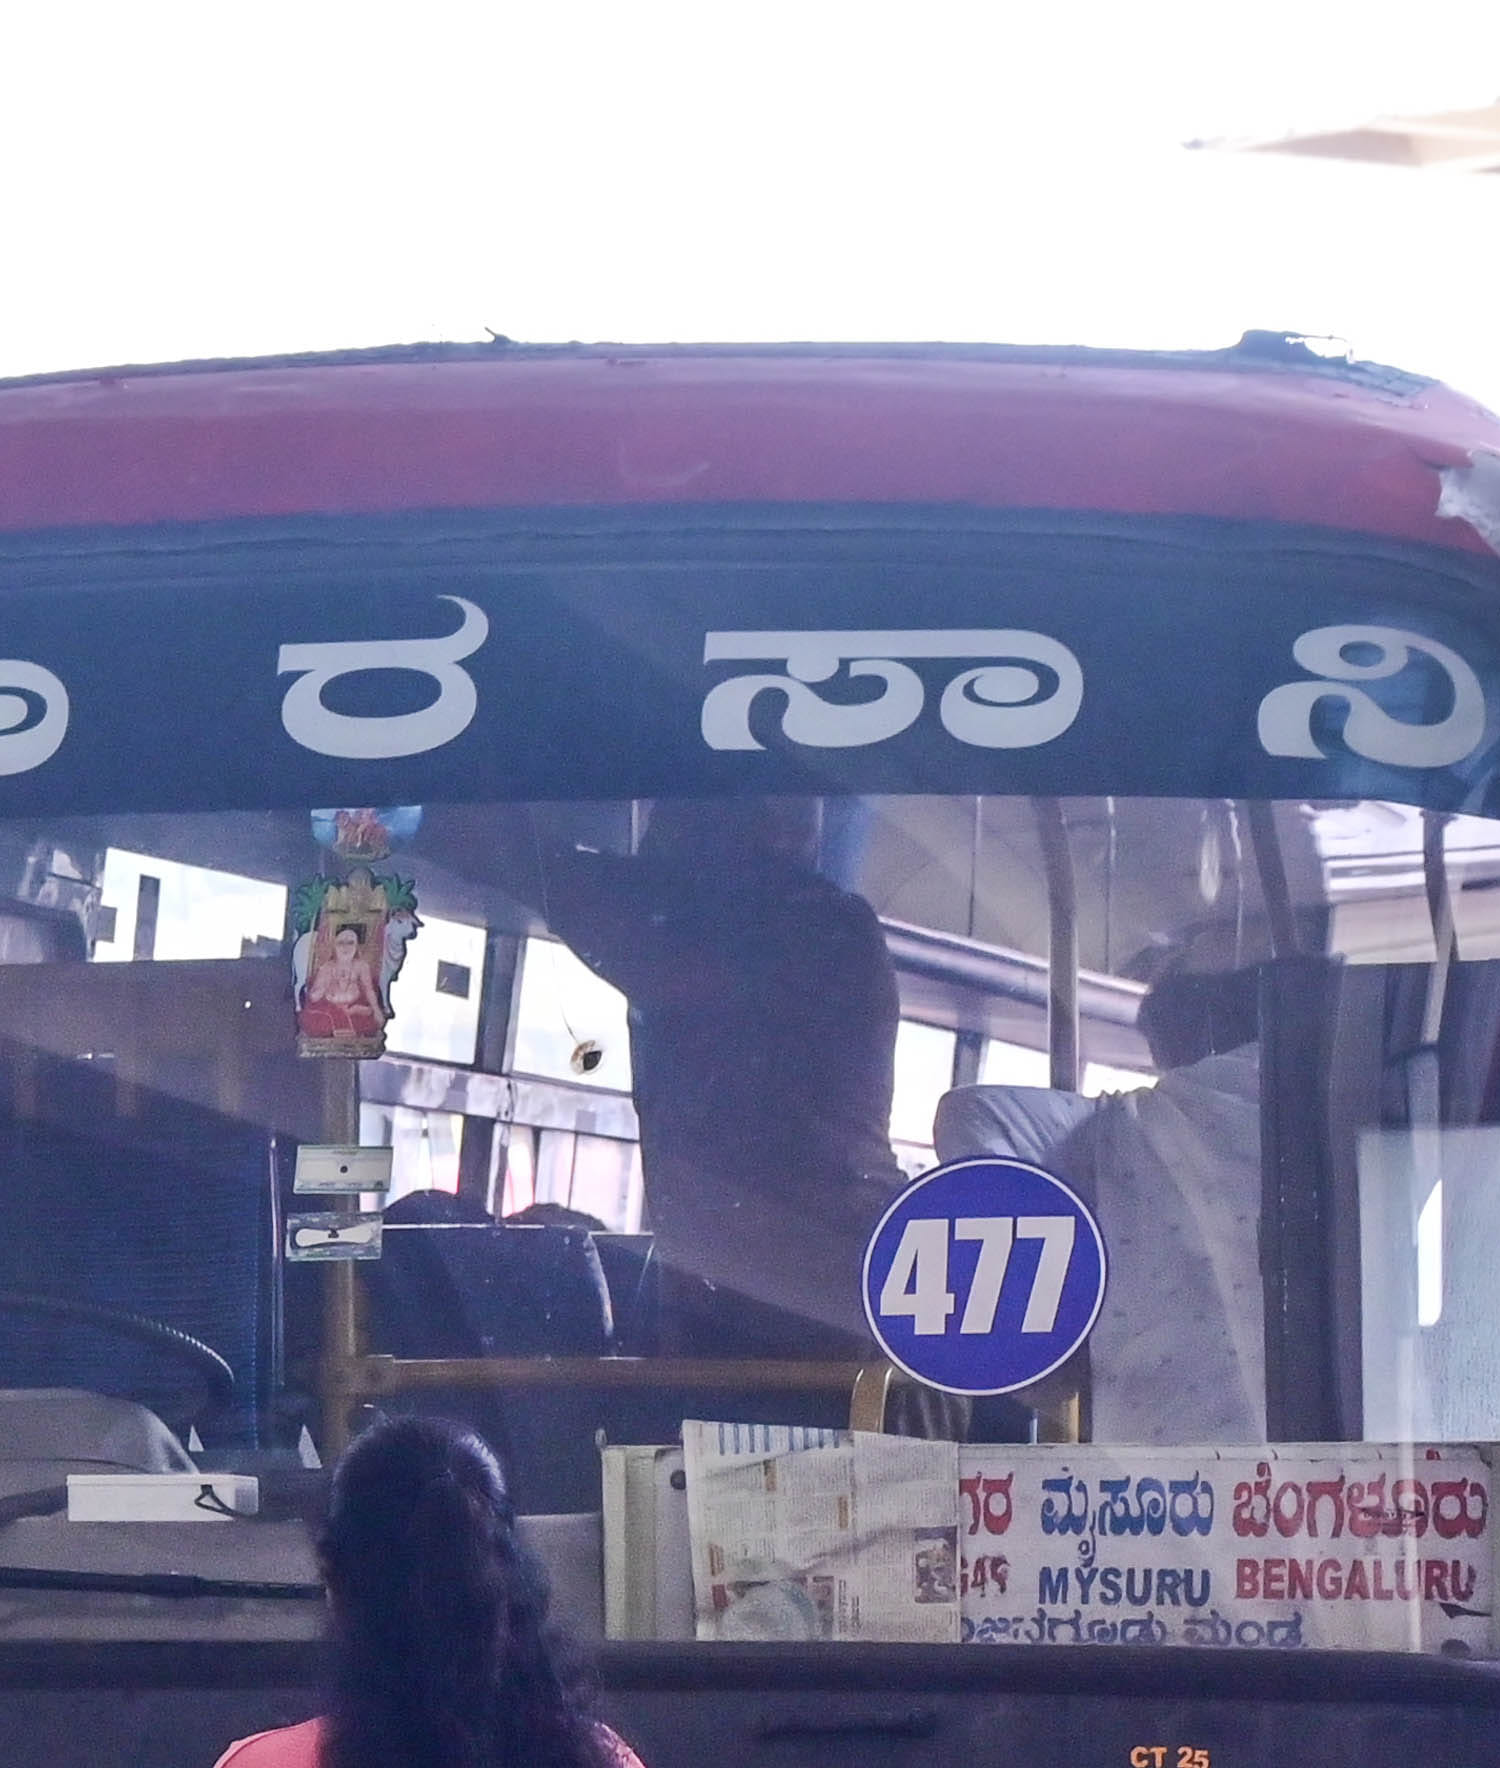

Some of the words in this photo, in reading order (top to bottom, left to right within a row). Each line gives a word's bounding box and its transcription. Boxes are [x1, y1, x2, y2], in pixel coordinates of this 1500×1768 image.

[879, 1215, 1076, 1336] 477
[1038, 1566, 1211, 1607] MYSURU
[1235, 1557, 1478, 1602] BENGALURU
[1130, 1746, 1167, 1768] CT
